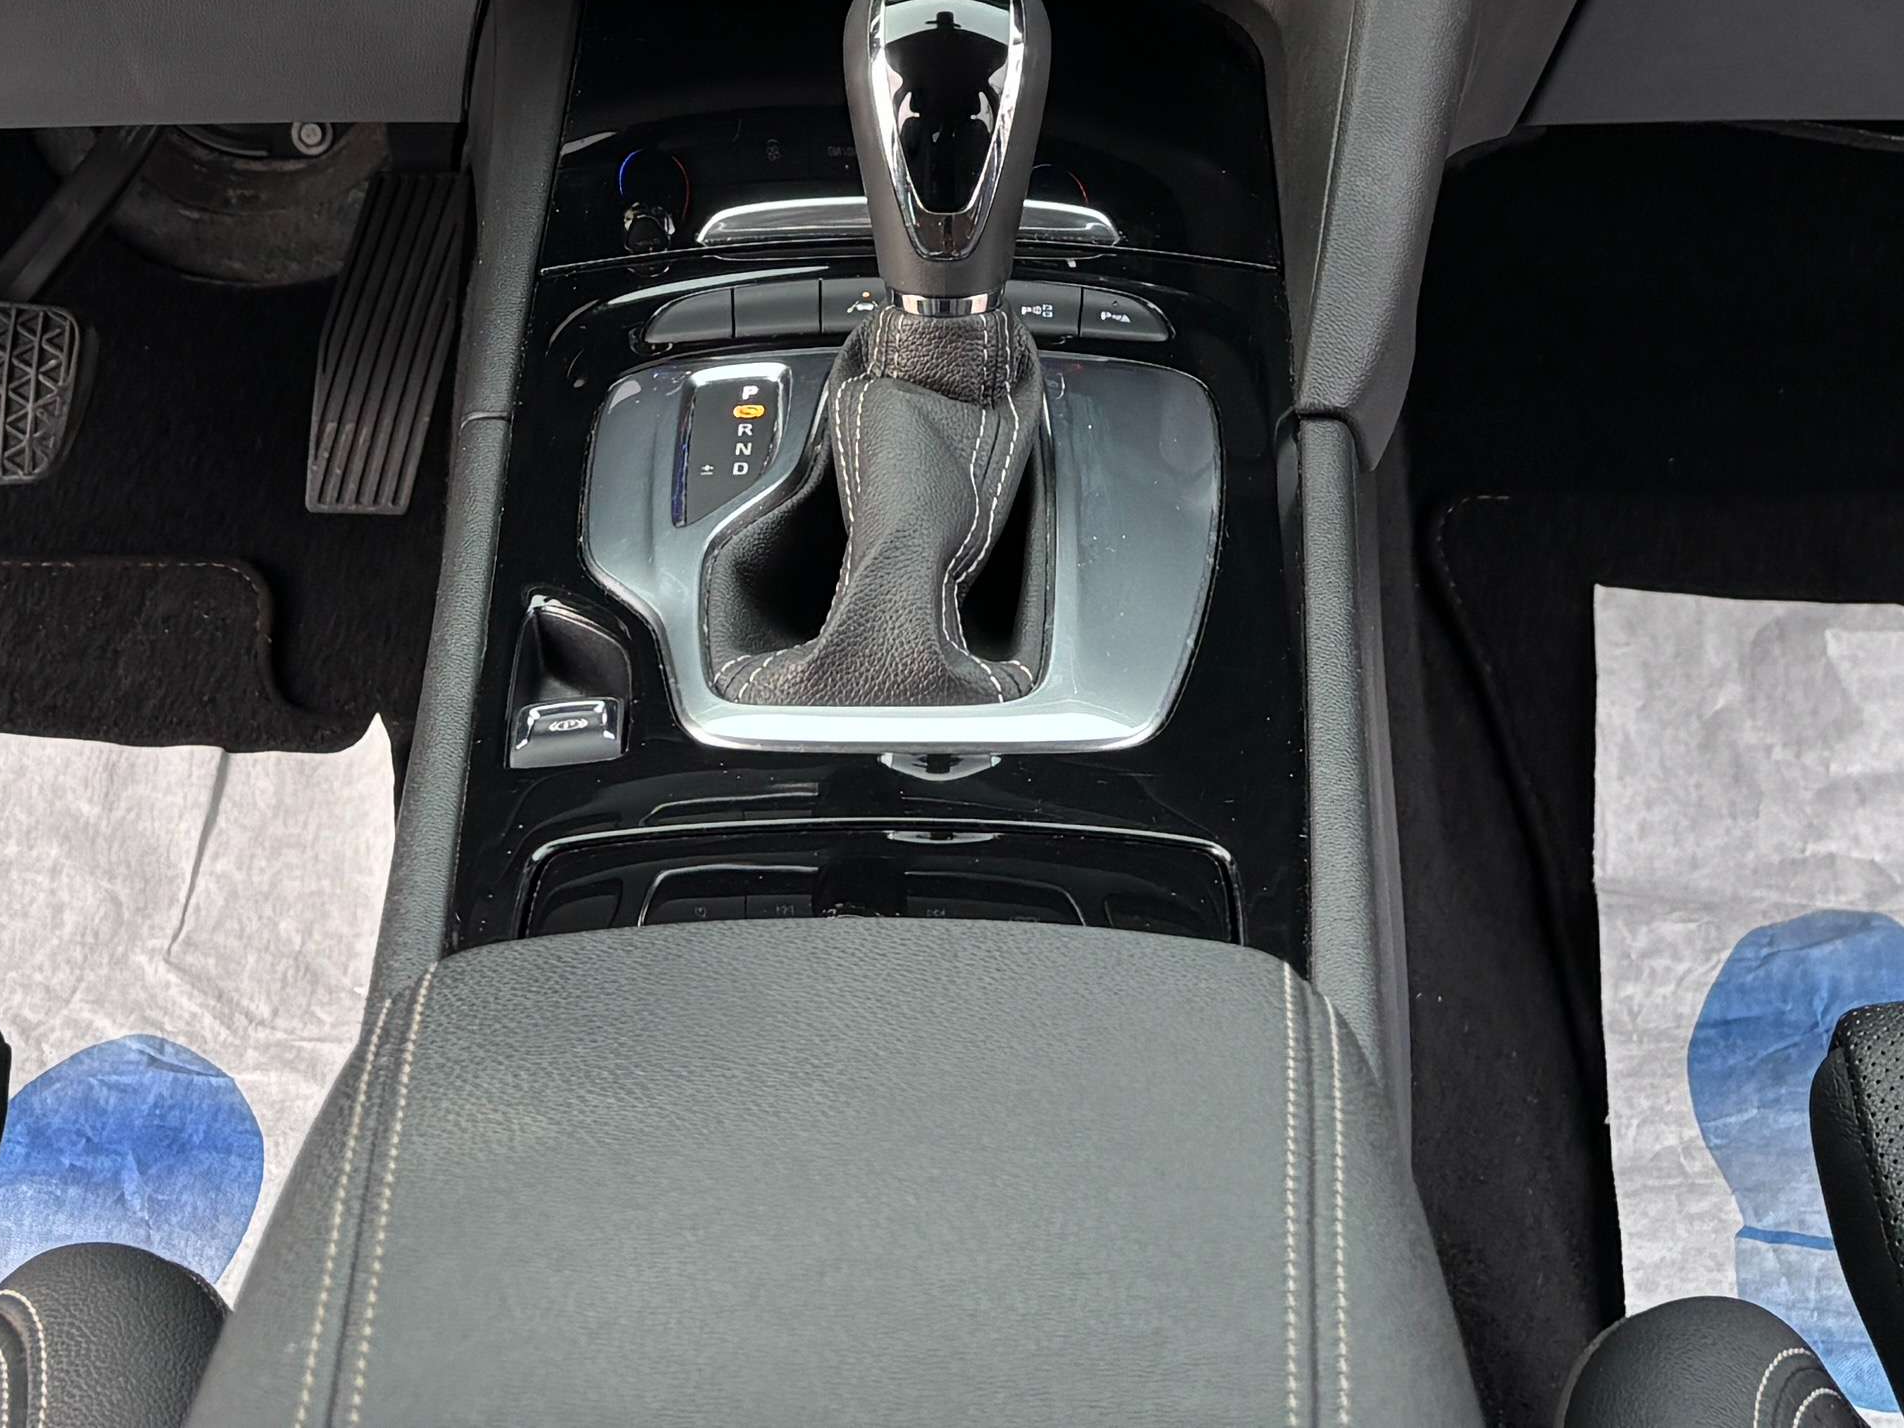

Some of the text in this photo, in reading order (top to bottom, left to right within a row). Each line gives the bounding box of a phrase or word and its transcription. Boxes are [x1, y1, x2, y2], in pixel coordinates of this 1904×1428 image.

[742, 385, 759, 400] P
[737, 423, 753, 437] R
[735, 442, 752, 456] N
[732, 462, 749, 476] D
